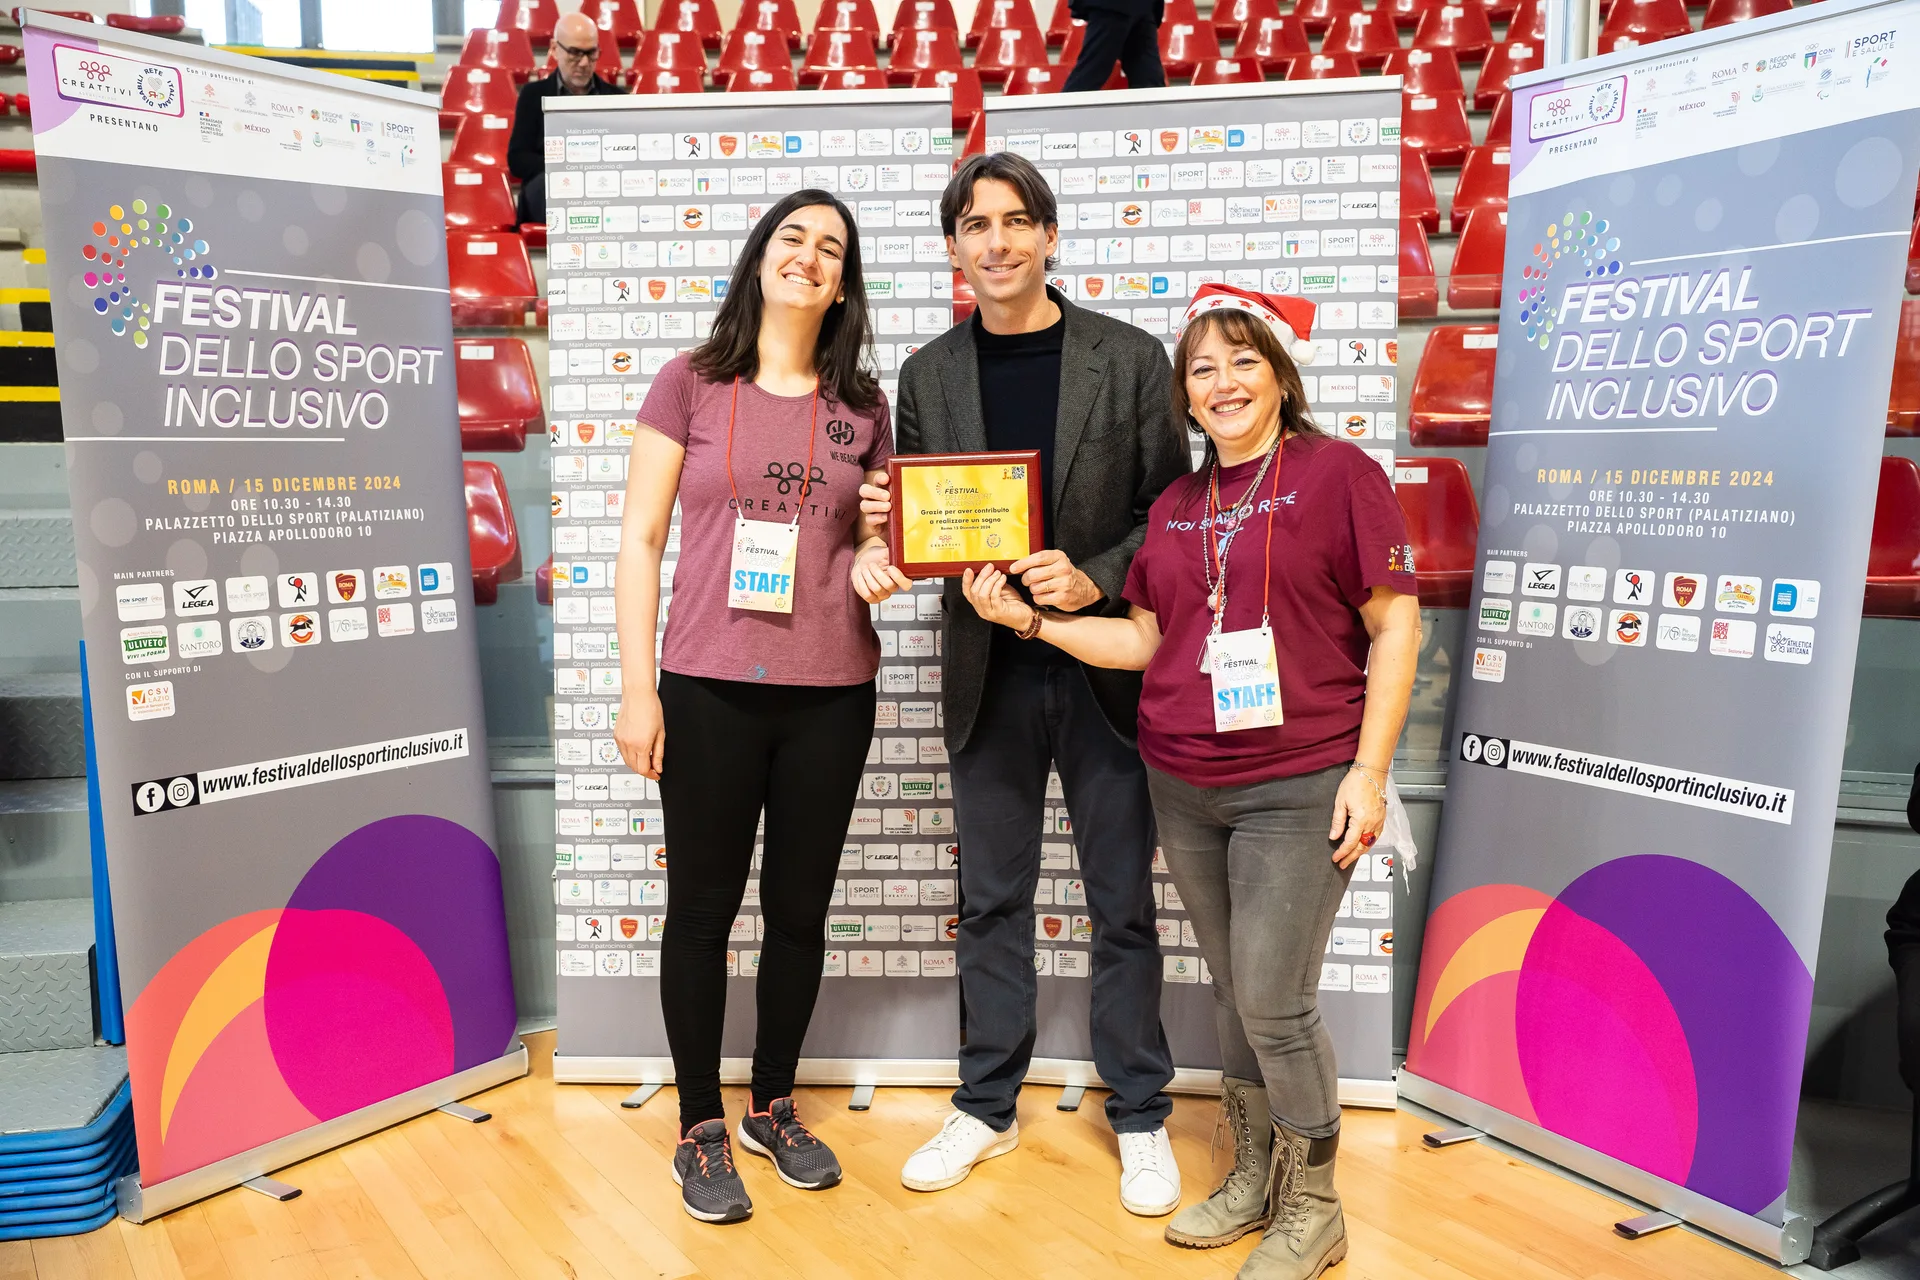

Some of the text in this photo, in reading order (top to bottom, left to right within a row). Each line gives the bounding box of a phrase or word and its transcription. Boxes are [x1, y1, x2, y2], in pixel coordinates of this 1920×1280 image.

[1854, 30, 1896, 48] SPORT
[1861, 42, 1895, 55] SALUTE
[1655, 59, 1689, 71] patrocinio
[1770, 53, 1796, 64] REGIONE
[144, 68, 163, 76] RETE
[1769, 61, 1787, 70] LAZIO
[187, 67, 199, 75] Con
[210, 72, 245, 84] patrocinio
[1711, 68, 1737, 79] ROMA
[62, 78, 132, 96] CREATTIVI
[1597, 83, 1612, 92] RETE
[271, 103, 294, 113] ROMA
[1679, 102, 1705, 111] MÉXICO
[322, 111, 343, 119] REGIONE
[1533, 114, 1584, 129] CREATTIVI
[90, 114, 158, 132] PRESENTANO
[244, 123, 271, 134] MÉXICO
[386, 123, 414, 134] SPORT
[392, 133, 415, 142] SALUTE
[1549, 137, 1598, 154] PRESENTANO
[737, 174, 763, 183] SPORT
[571, 217, 597, 225] ULIVETO
[1557, 265, 1759, 324] FESTIVAL
[153, 281, 357, 335] FESTIVAL
[1477, 337, 1484, 346] 7
[1551, 308, 1873, 373] DELLO SPORT
[159, 332, 443, 384] DELLO SPORT
[1546, 369, 1778, 420] INCLUSIVO
[163, 384, 389, 430] INCLUSIVO
[830, 451, 858, 463] WE BEACH
[1405, 470, 1411, 480] 6
[1537, 469, 1774, 486] ROMA 15 DICEMBRE 2024
[168, 475, 401, 495] ROMA 15 DICEMBRE 2024
[1589, 490, 1710, 504] ORE 10.30 14.30
[231, 496, 351, 512] ORE 10.30 14.30
[729, 498, 846, 521] CREATTIVI
[1166, 520, 1196, 531] NOI
[1258, 491, 1297, 513] RETE
[1514, 503, 1795, 526] PALAZZETTO DELLO SPORT (PALATIZIANO)
[145, 508, 425, 531] PALAZZETTO DELLO SPORT (PALATIZIANO)
[213, 526, 372, 544] PIAZZA APOLLODORO 10
[1567, 520, 1726, 538] PIAZZA APOLLODORO 10
[746, 547, 779, 556] FESTIVAL
[114, 570, 174, 580] MAIN PARTNERS
[734, 570, 790, 594] STAFF
[1528, 582, 1555, 590] LEGEA
[182, 600, 214, 608] LEGEA
[1483, 611, 1507, 619] ULIVETO
[1519, 620, 1554, 630] SANTORO
[129, 639, 162, 649] ULIVETO
[180, 640, 221, 652] SANTORO
[1494, 638, 1523, 647] SUPPORTO
[1224, 659, 1258, 668] FESTIVAL
[125, 672, 141, 680] CON
[154, 667, 190, 677] SUPPORTO
[1217, 683, 1275, 711] STAFF
[202, 733, 463, 795] www.festivaldellosportinclusivo.it
[1512, 748, 1786, 813] www.festivaldellosportinclusivo.it
